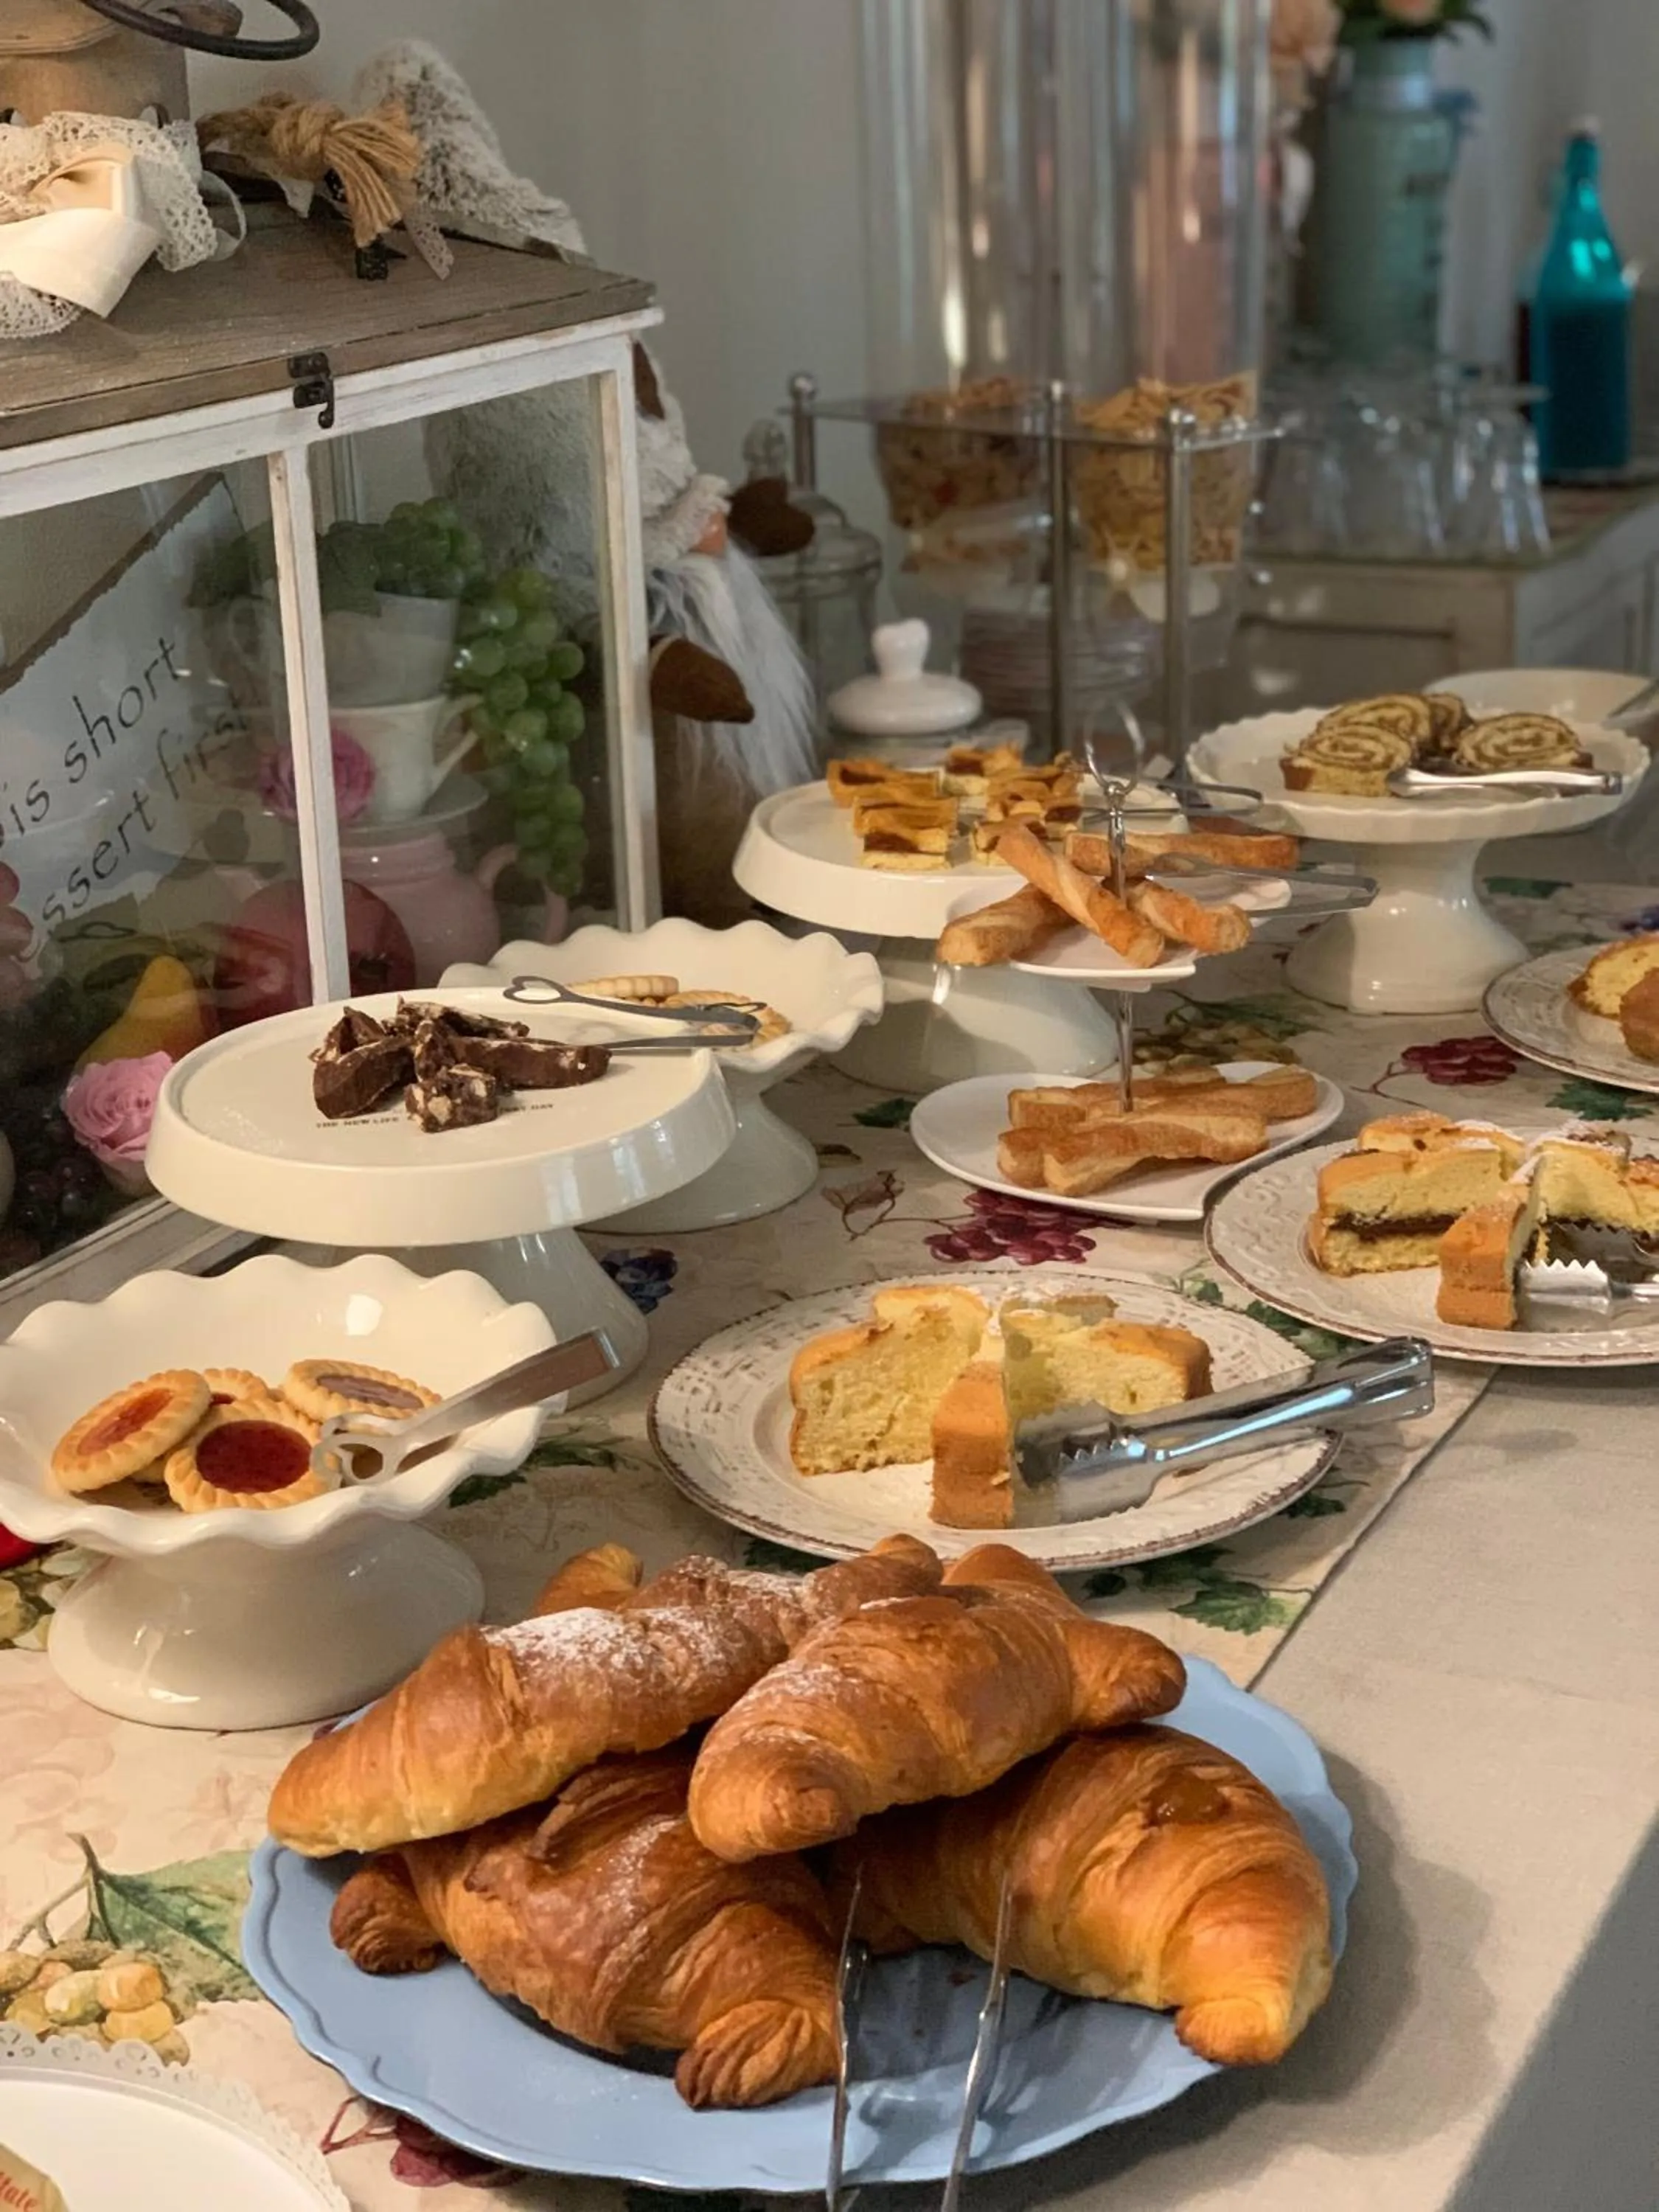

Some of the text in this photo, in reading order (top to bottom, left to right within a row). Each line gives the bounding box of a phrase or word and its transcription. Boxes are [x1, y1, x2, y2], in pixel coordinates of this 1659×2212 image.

[2, 637, 180, 836] is short
[18, 790, 154, 962] ssert
